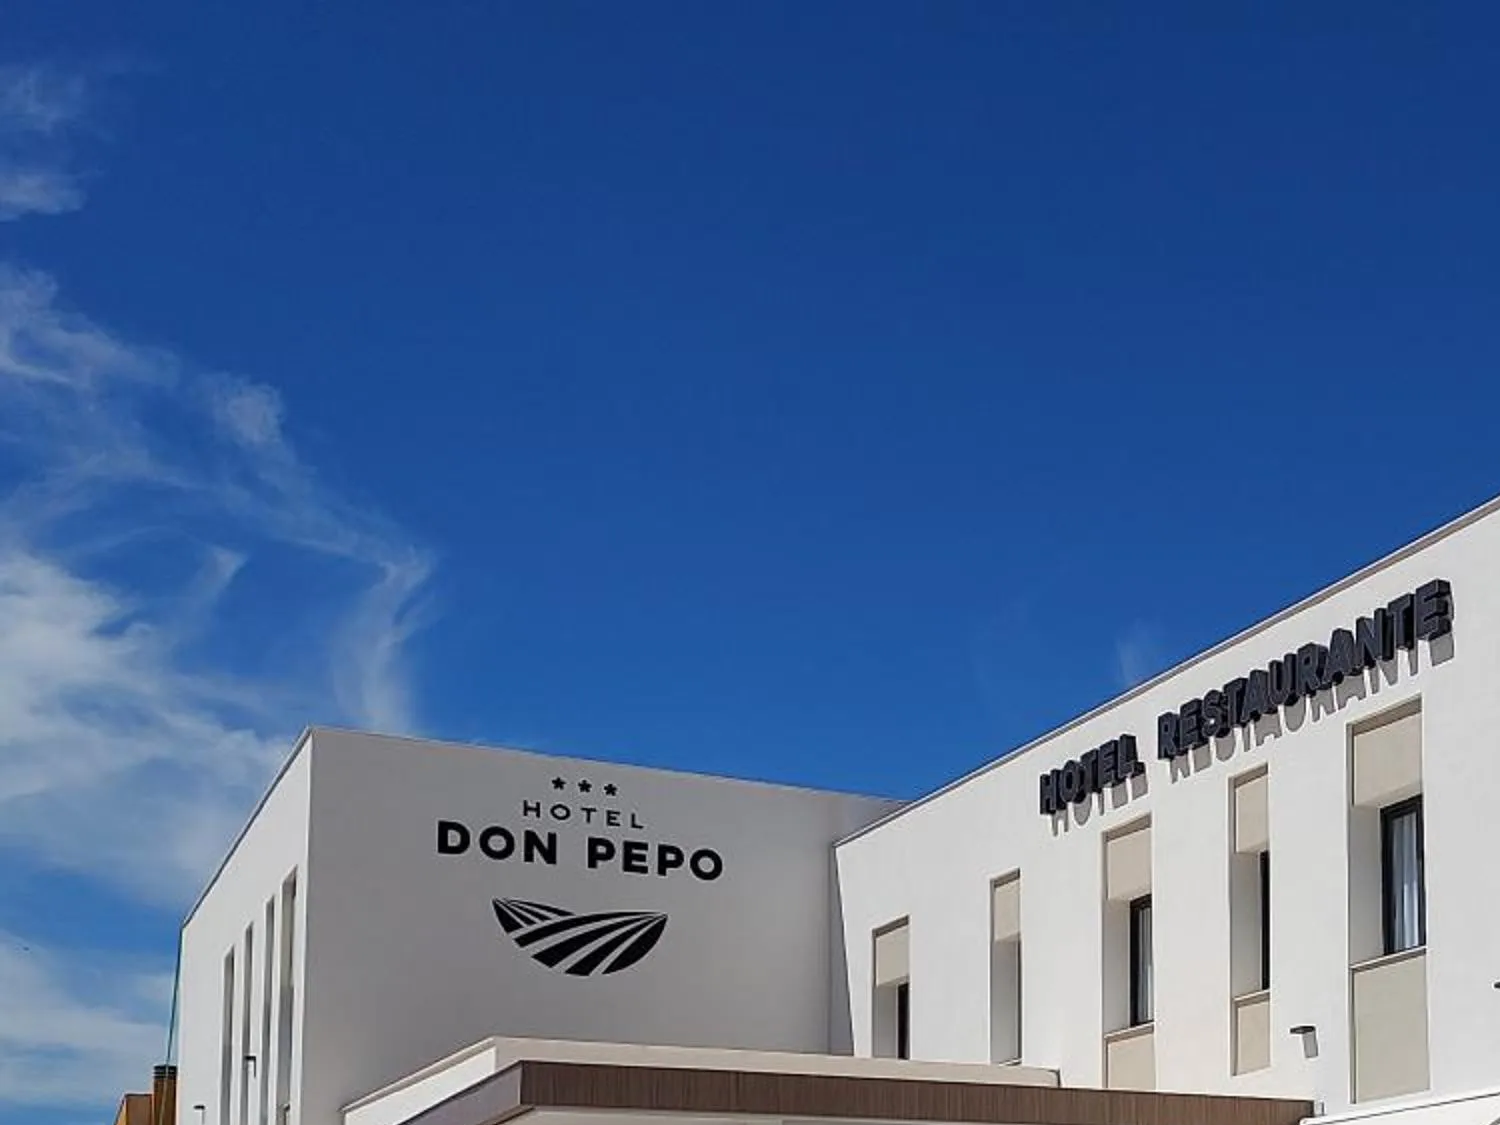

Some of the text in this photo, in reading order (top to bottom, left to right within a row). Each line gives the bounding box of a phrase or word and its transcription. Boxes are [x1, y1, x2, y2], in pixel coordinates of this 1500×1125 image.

[1040, 733, 1145, 815] HOTEL
[1157, 578, 1454, 761] RESTAURANTE
[523, 800, 644, 829] HOTEL
[437, 820, 724, 881] DON PEPO
